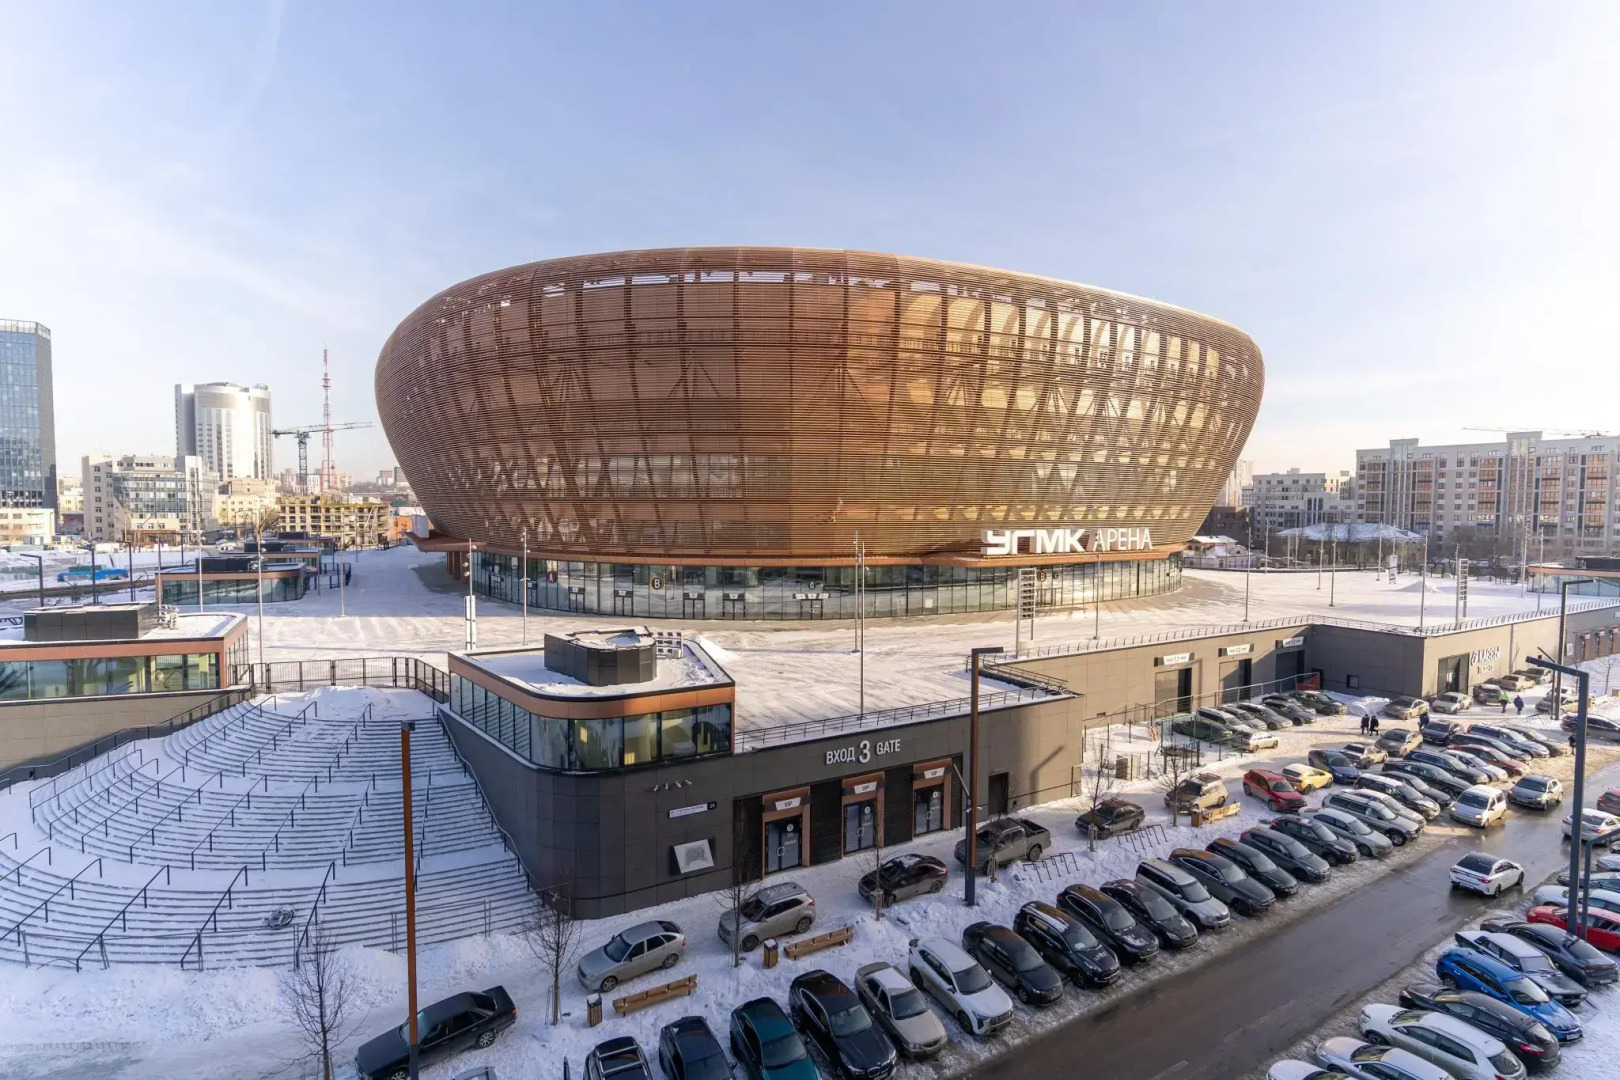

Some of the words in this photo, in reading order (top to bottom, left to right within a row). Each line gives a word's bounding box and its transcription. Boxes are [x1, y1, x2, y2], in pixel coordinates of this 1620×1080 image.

[984, 529, 1087, 555] УГМК
[1093, 527, 1153, 552] АРЕНА
[654, 579, 660, 589] B
[825, 747, 856, 765] ВХОД
[859, 740, 871, 763] 3
[876, 739, 901, 755] GATE
[784, 800, 793, 808] VIP
